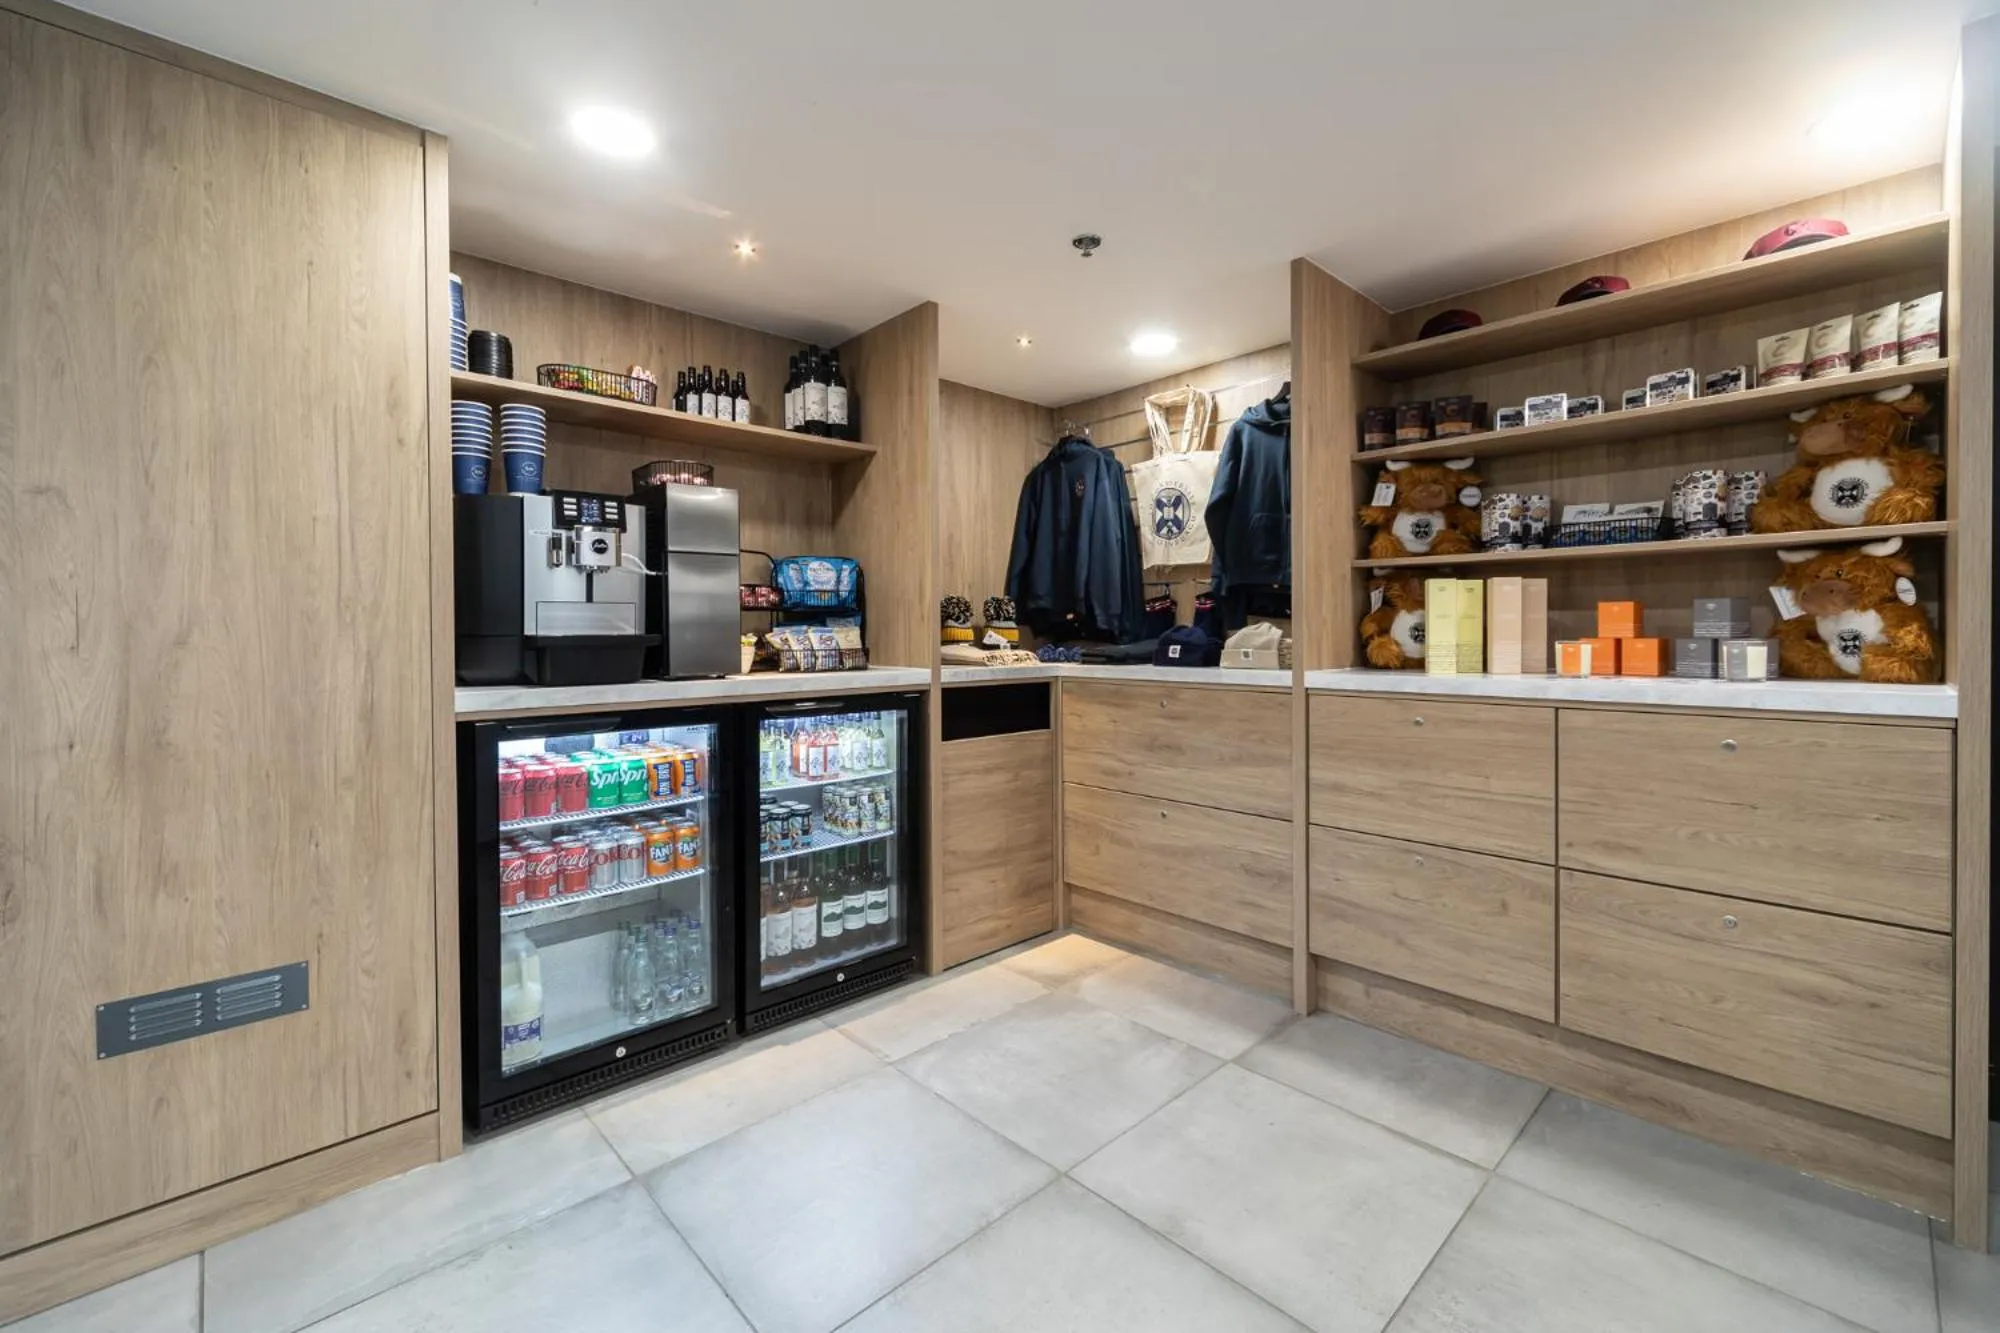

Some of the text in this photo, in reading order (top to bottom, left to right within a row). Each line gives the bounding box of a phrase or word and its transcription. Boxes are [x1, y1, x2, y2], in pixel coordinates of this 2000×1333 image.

[590, 765, 620, 789] Spr
[619, 762, 647, 786] Spri
[678, 840, 697, 855] FAN
